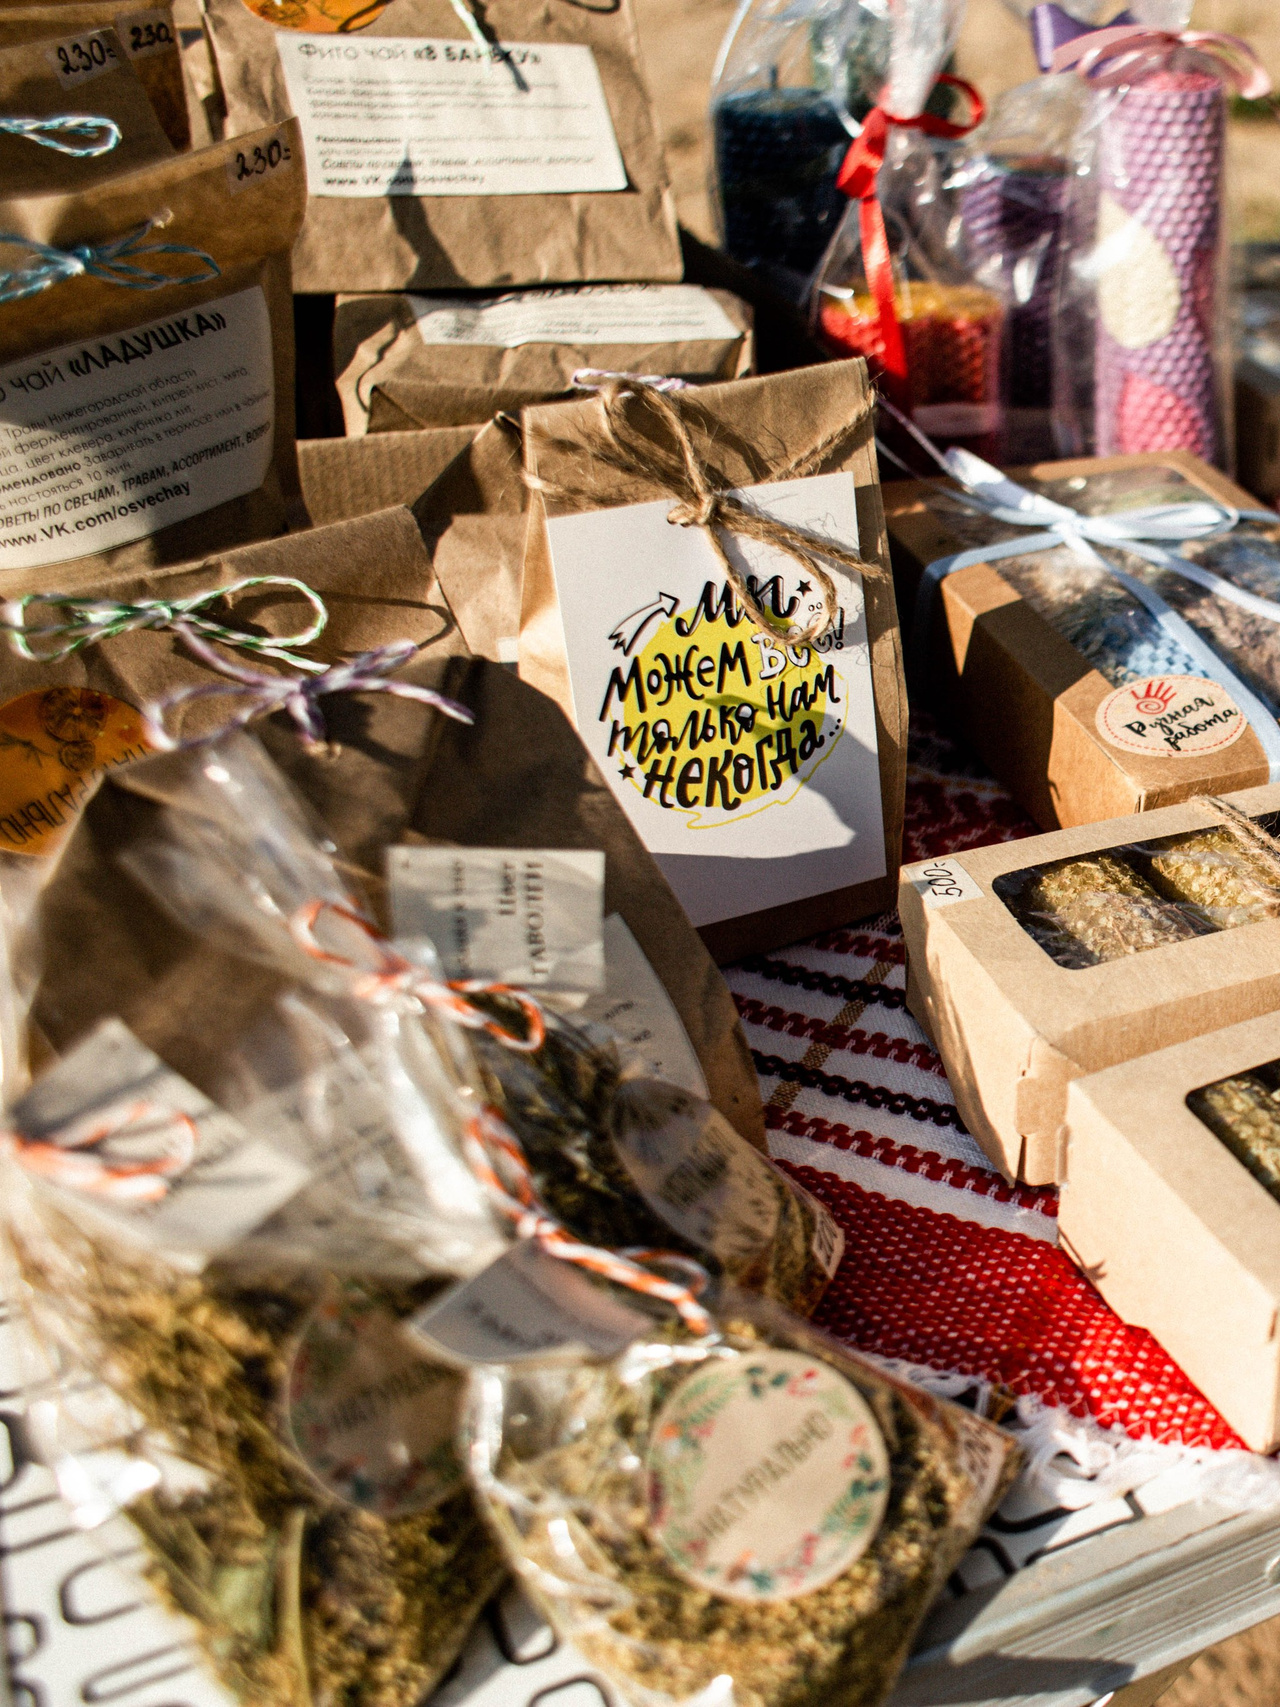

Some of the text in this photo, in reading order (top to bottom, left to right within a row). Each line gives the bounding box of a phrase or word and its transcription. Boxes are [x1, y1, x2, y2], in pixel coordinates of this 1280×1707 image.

[10, 312, 227, 394] чай «ЛАДУШКА»
[5, 422, 48, 440] Травы
[0, 462, 82, 493] мендовано
[26, 452, 56, 470] цвет
[9, 479, 84, 507] настояться
[87, 470, 103, 483] 10
[43, 503, 61, 518] ПО
[64, 484, 120, 512] СВЕЧАМ,
[122, 465, 170, 492] ТРАВАМ,
[1122, 696, 1215, 738] Ручная
[1163, 708, 1238, 752] работа
